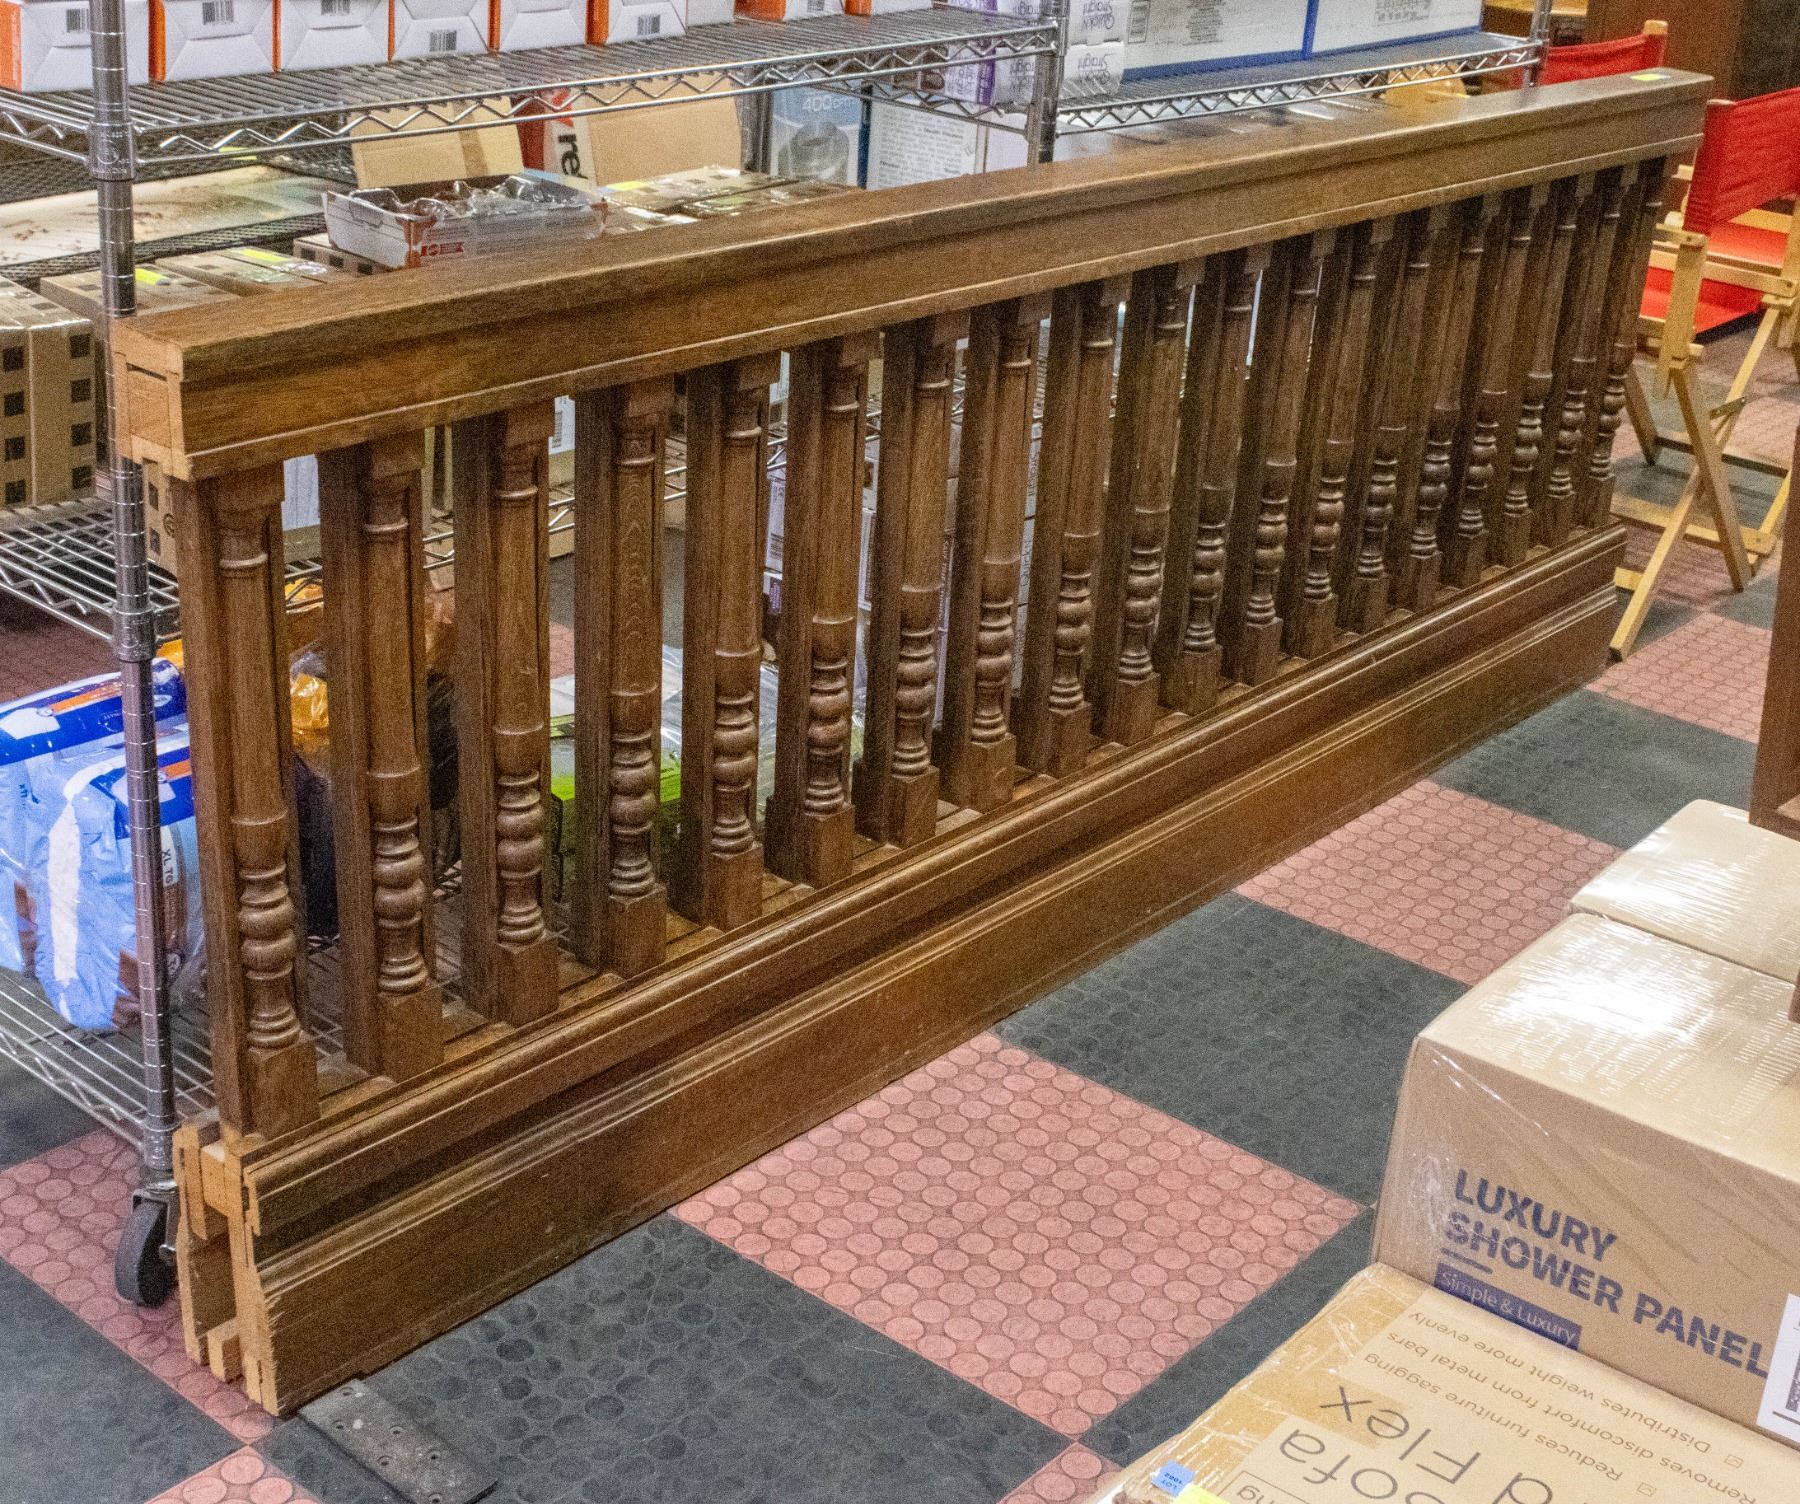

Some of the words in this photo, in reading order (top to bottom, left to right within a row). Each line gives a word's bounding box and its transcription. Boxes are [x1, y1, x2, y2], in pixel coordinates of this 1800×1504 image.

[1454, 1169, 1618, 1263] LUXURY
[1440, 1270, 1498, 1308] Simple
[1499, 1298, 1513, 1313] &
[1516, 1305, 1579, 1346] Luxury
[1444, 1209, 1624, 1315] SHOWER
[1633, 1292, 1768, 1380] PANEL
[1386, 1331, 1428, 1356] bars
[1408, 1310, 1471, 1349] evenly
[1483, 1339, 1525, 1368] more
[1364, 1352, 1441, 1396] sagging
[1431, 1352, 1487, 1385] metal
[1528, 1358, 1595, 1401] weight
[1444, 1390, 1530, 1441] furniture
[1497, 1379, 1540, 1410] from
[1320, 1385, 1481, 1486] Flex
[1542, 1395, 1655, 1465] discomfort
[1599, 1396, 1713, 1456] Distributes
[1534, 1431, 1625, 1482] Reduces
